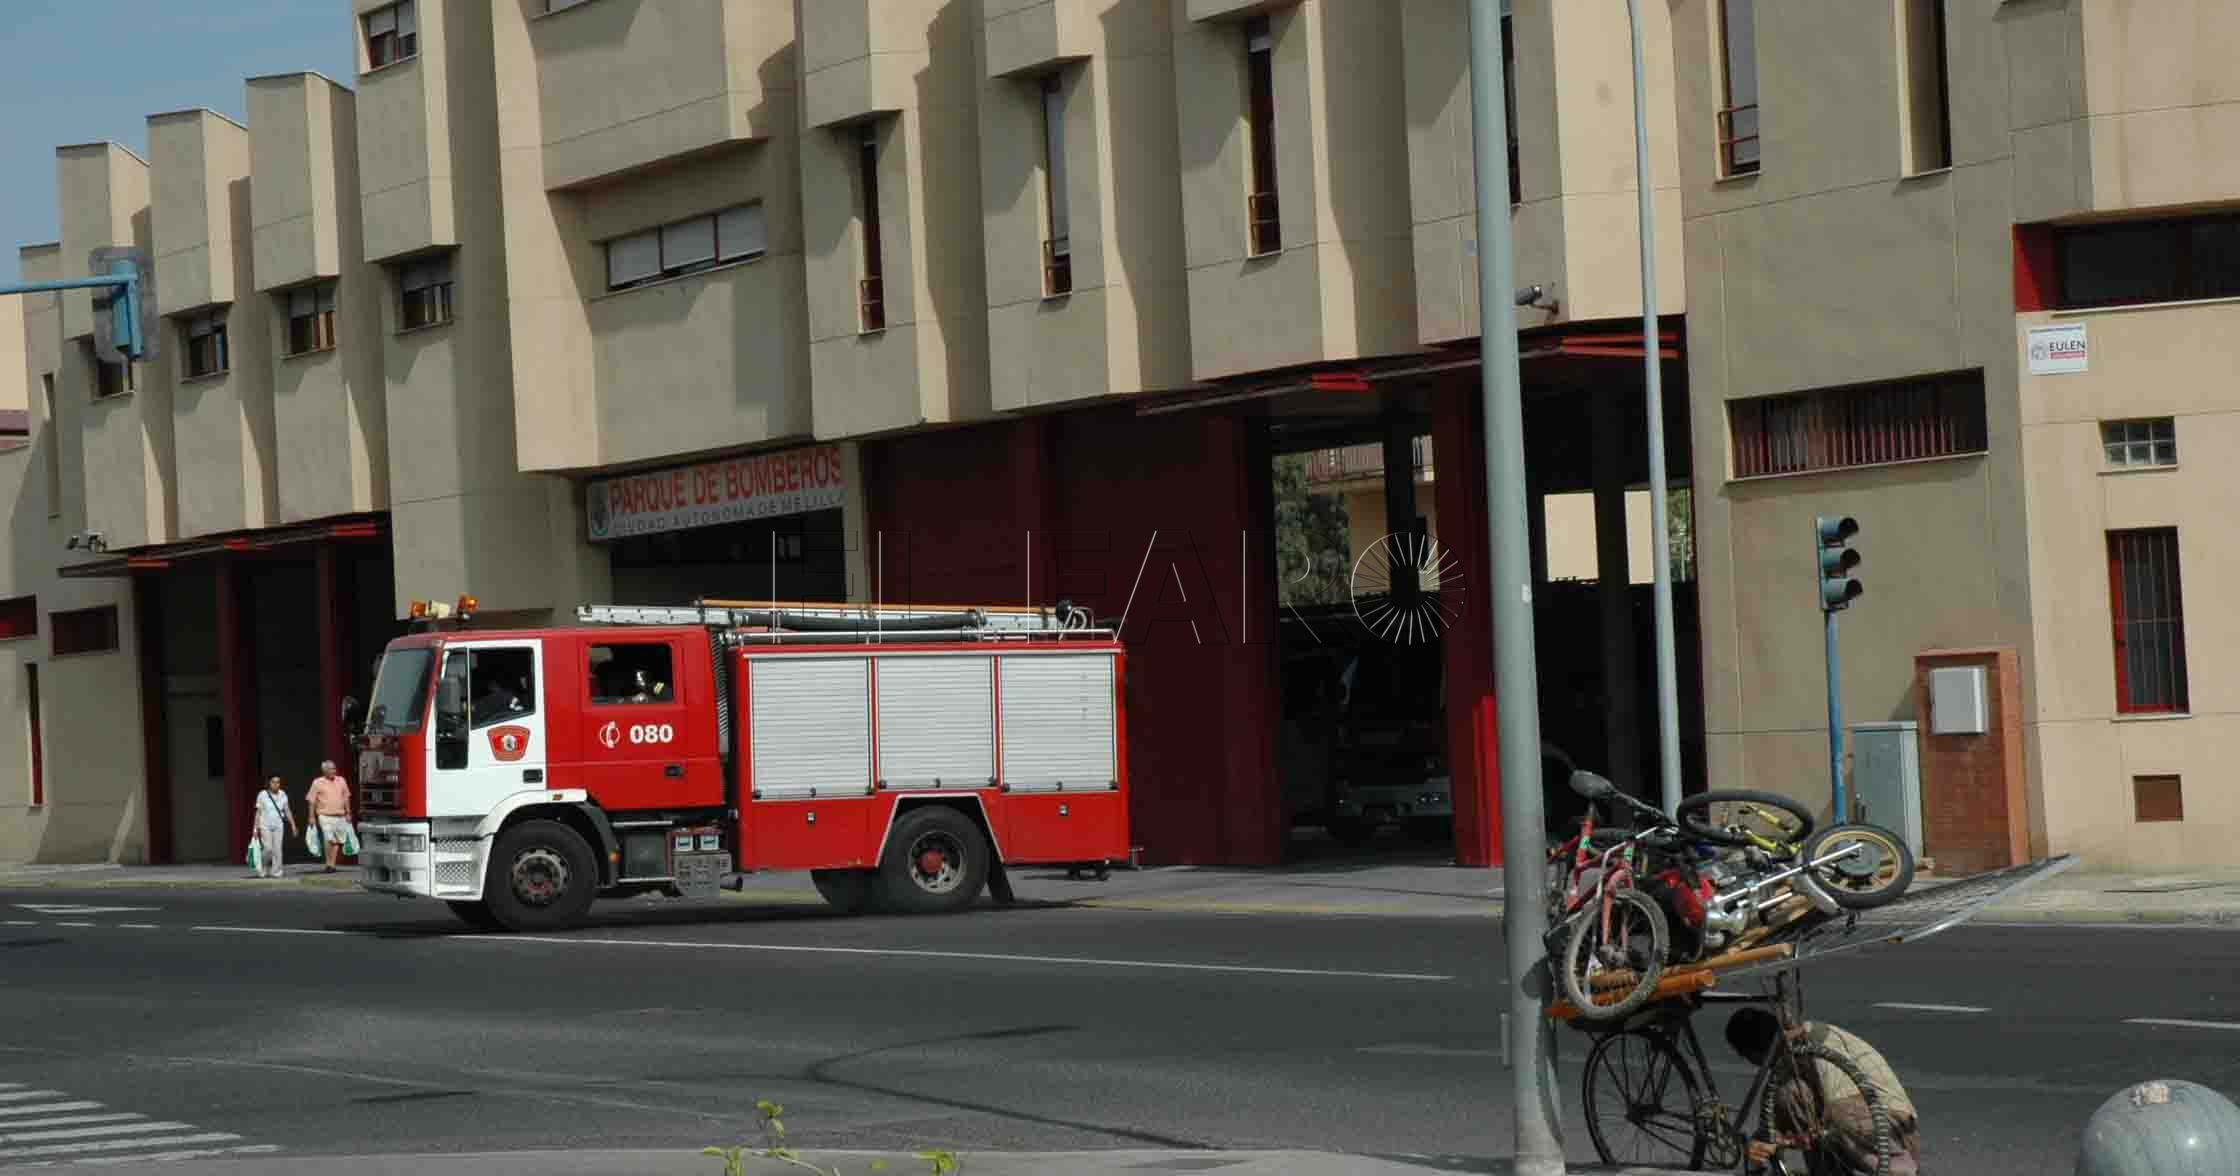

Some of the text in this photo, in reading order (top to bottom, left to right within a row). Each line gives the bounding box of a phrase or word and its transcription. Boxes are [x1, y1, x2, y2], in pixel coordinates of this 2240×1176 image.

[2049, 339, 2086, 352] EULEN
[609, 448, 843, 513] PARQUE DE BOMBEROS
[759, 501, 777, 516] DE
[630, 725, 673, 744] 080
